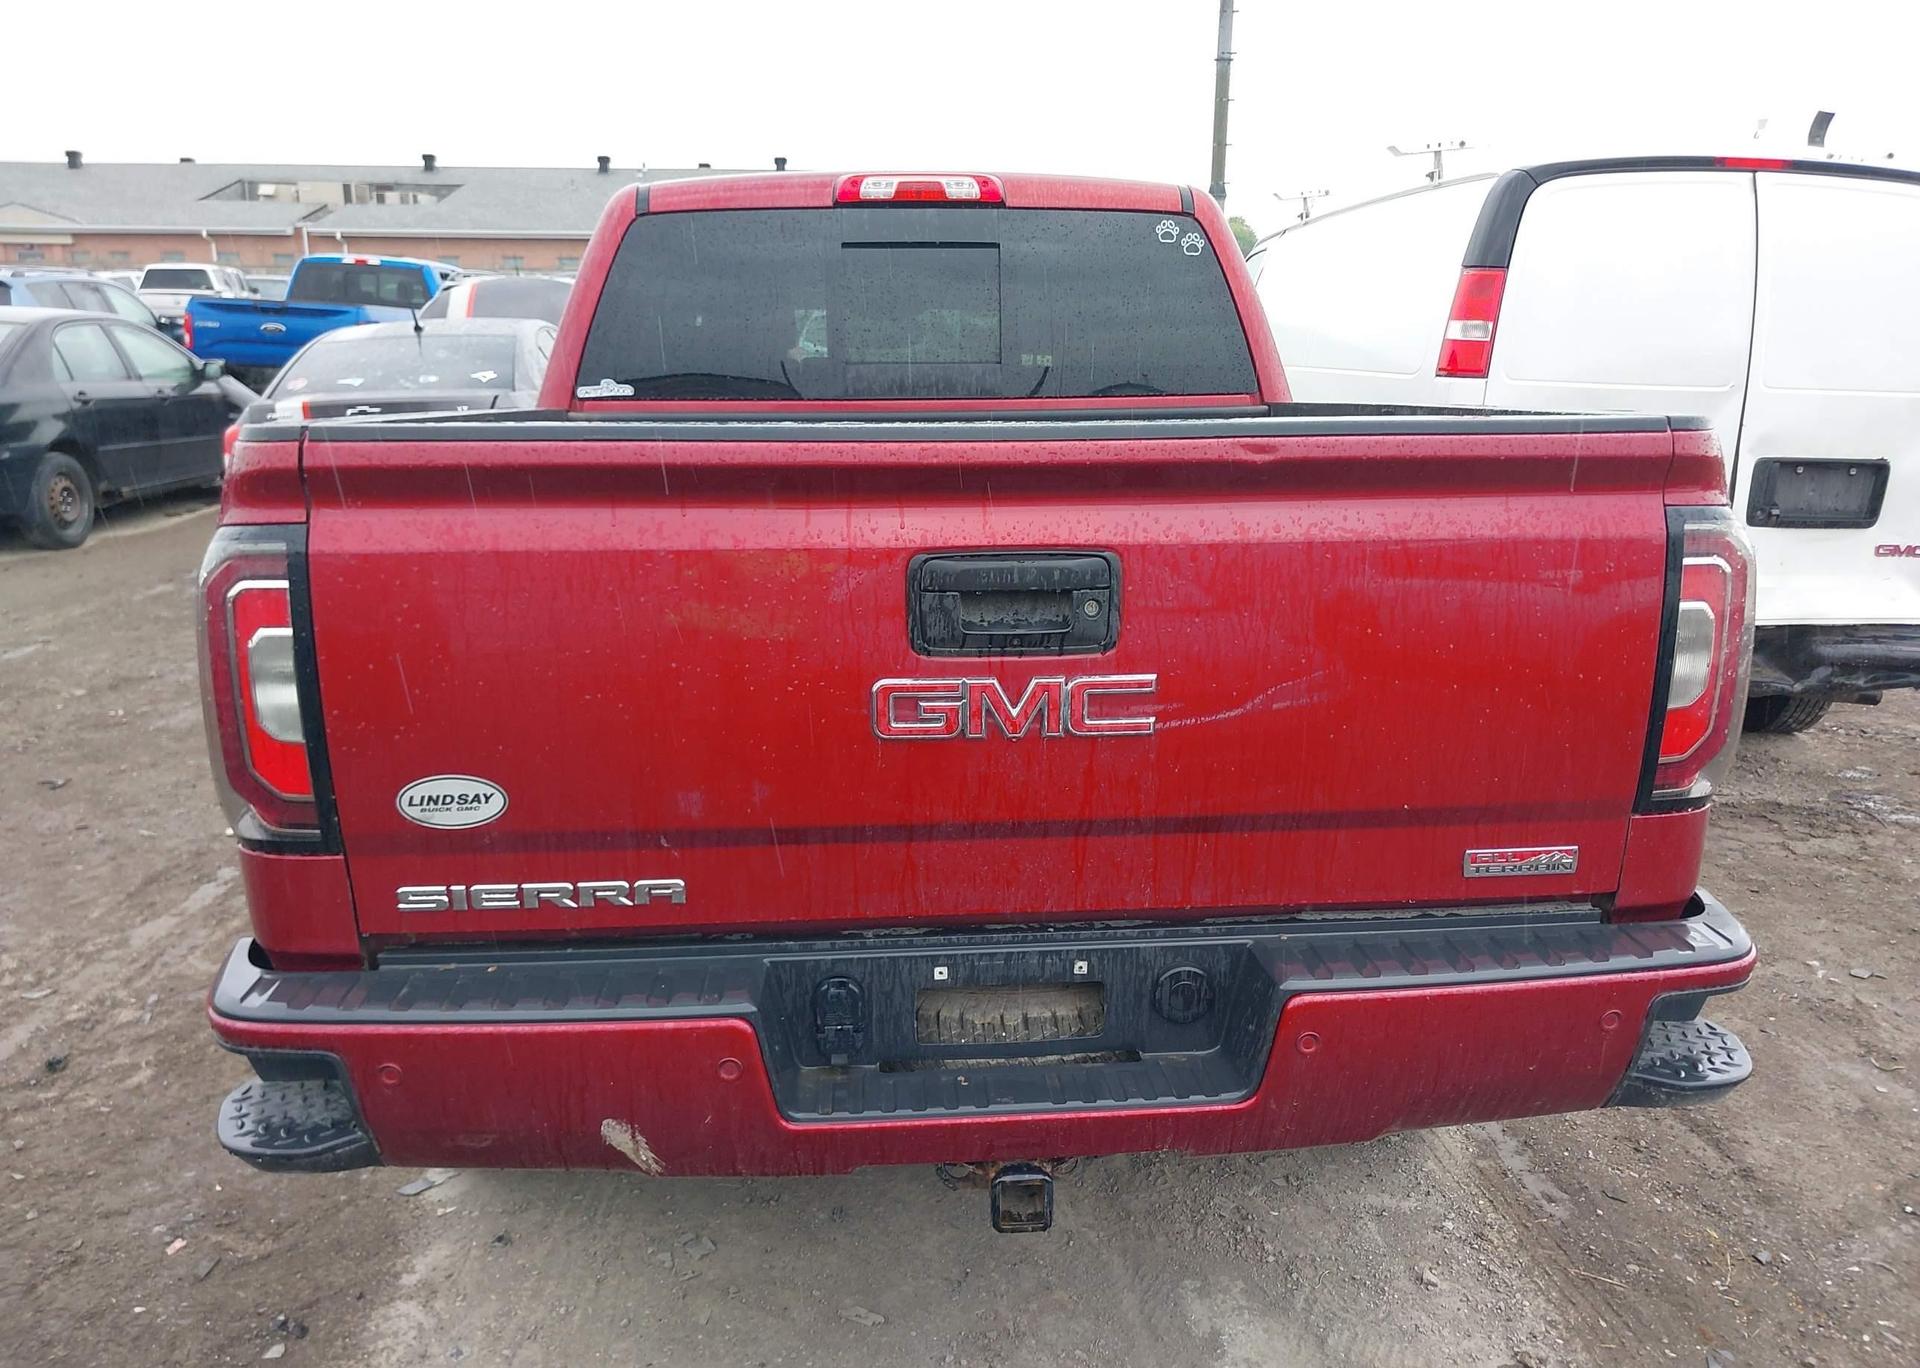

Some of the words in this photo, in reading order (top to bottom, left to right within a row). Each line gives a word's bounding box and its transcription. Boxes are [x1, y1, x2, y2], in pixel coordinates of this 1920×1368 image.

[872, 673, 1157, 739] GMC
[408, 793, 495, 807] LINDSAY
[1477, 852, 1521, 863] ALL
[1470, 862, 1574, 874] TERRAIN
[396, 878, 686, 911] SIERRA
